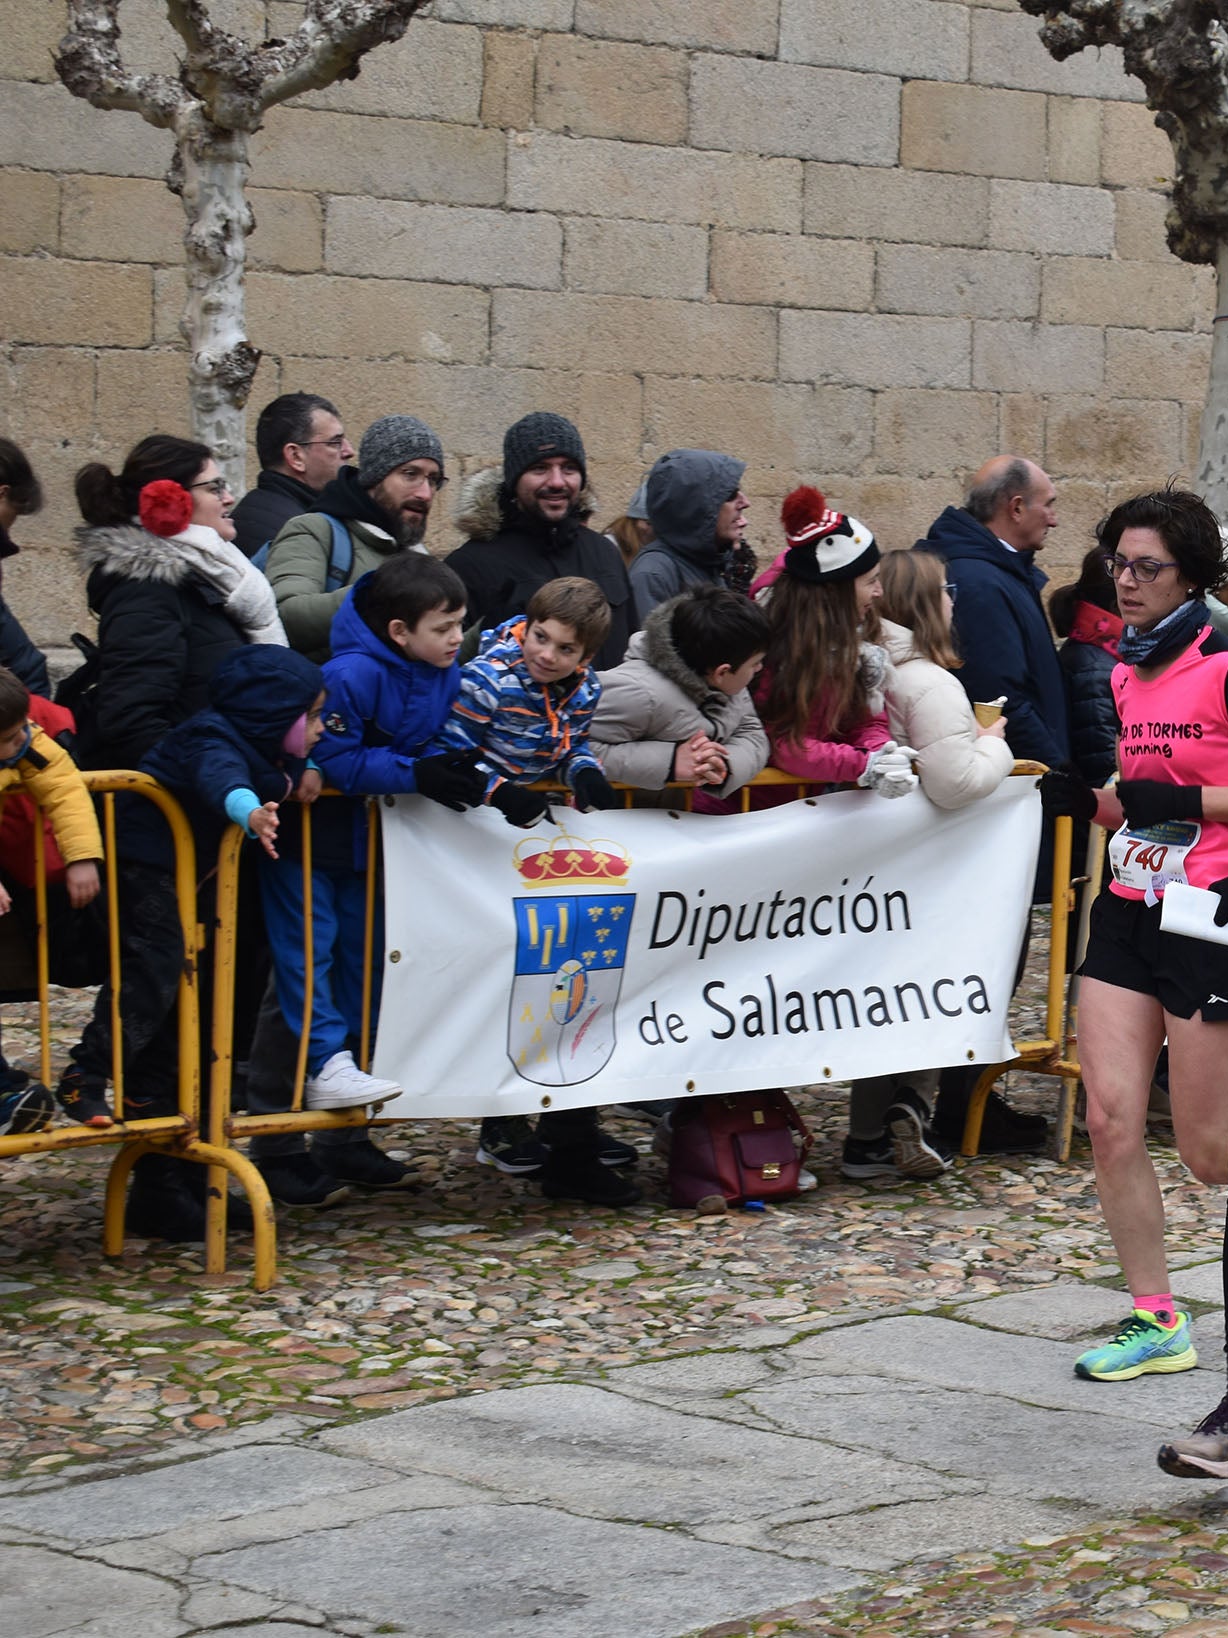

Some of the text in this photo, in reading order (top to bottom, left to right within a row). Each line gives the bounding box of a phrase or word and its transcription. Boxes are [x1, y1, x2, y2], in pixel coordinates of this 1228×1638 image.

[1131, 723, 1143, 739] DE
[1147, 722, 1203, 739] TORMES
[1125, 742, 1173, 759] running
[1122, 839, 1168, 873] 740
[648, 876, 912, 959] Diputación
[638, 973, 991, 1046] de Salamanca
